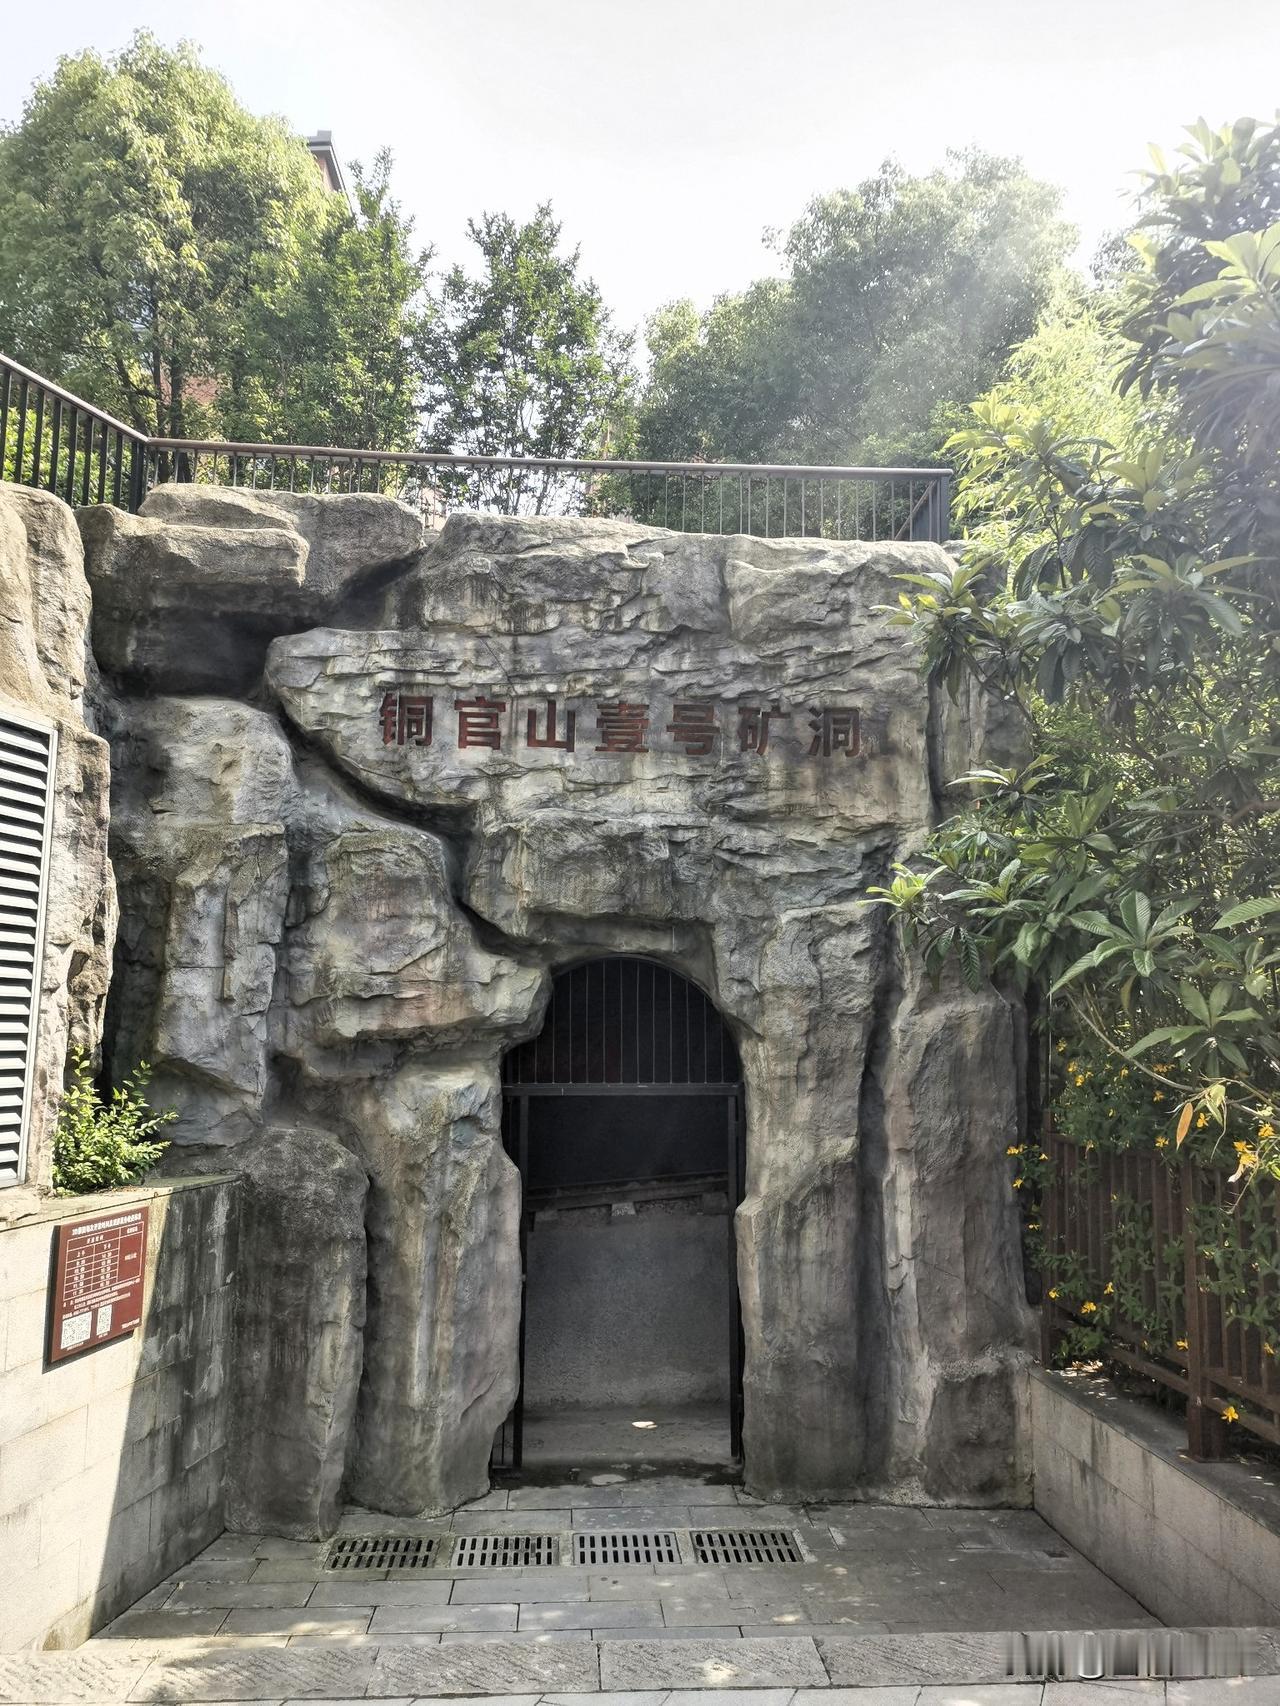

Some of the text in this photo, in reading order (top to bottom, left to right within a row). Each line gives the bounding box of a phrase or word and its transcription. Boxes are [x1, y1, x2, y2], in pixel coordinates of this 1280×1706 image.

[379, 692, 861, 757] 铜官山壹号矿洞
